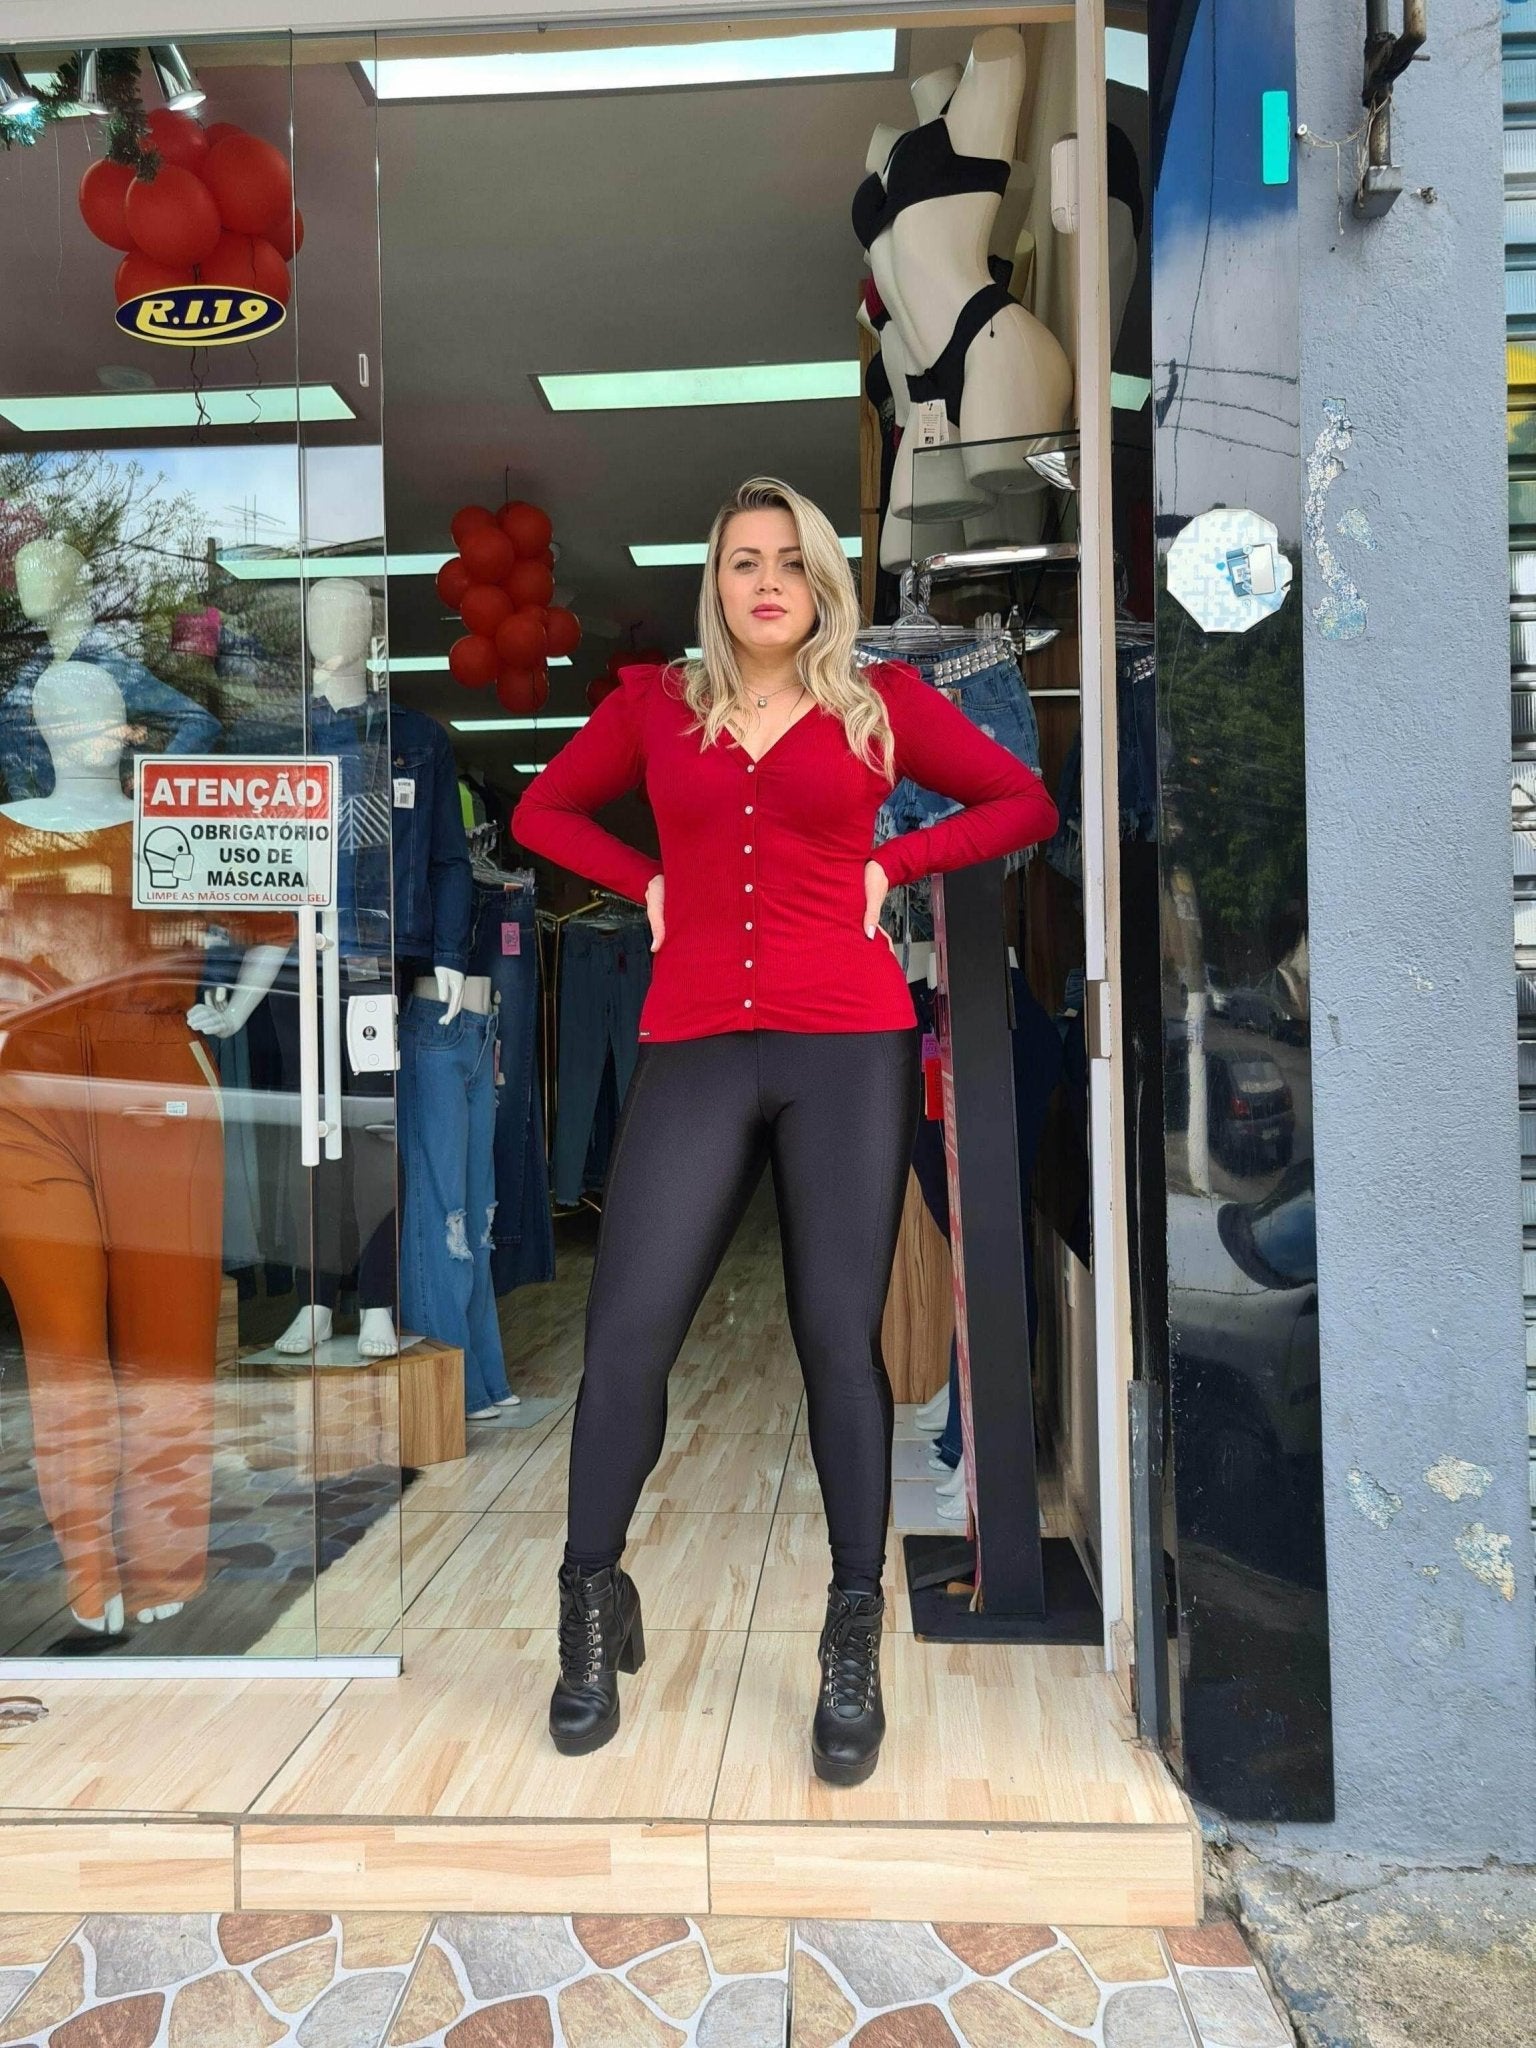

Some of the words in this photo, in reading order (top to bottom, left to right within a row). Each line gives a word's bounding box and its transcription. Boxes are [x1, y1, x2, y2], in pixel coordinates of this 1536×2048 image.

[136, 299, 269, 338] R.I.19
[150, 772, 322, 813] ATENÇÃO
[190, 822, 329, 841] OBRIGATÓRIO
[219, 848, 261, 864] USO
[267, 848, 293, 864] DE
[207, 867, 305, 888] MÁSCARA
[146, 892, 179, 900] LIMPE
[181, 892, 195, 900] AS
[198, 891, 230, 901] MÃOS
[233, 893, 261, 902] COM
[263, 891, 304, 902] ÁLCOOL
[307, 894, 327, 903] GEL
